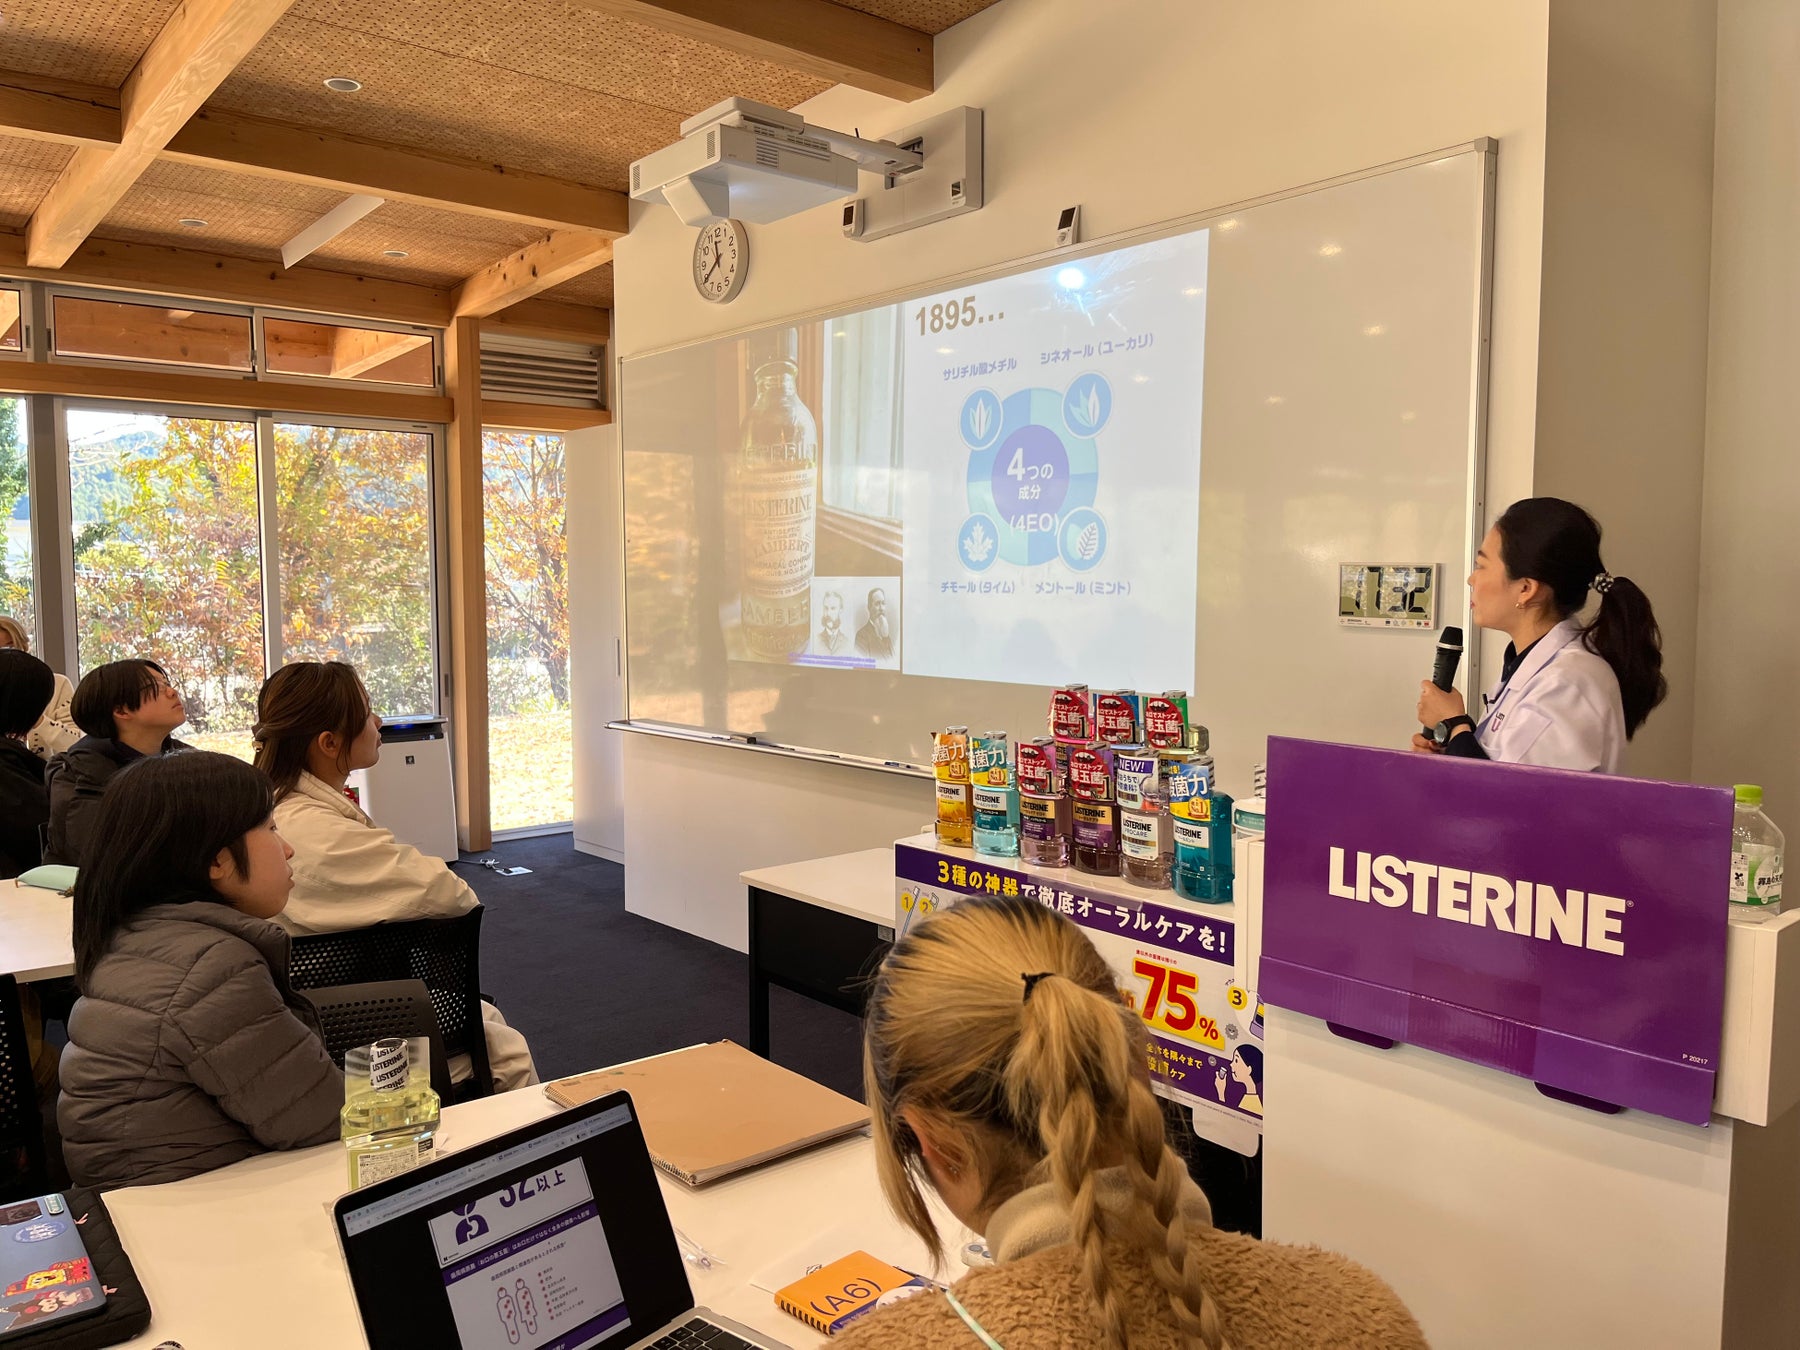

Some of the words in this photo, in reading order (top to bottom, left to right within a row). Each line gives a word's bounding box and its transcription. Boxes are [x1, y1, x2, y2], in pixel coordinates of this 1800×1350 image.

[1007, 447, 1054, 481] 4つの
[1018, 484, 1041, 500] 成分
[1099, 708, 1130, 717] 口でストップ
[1119, 758, 1145, 773] NEW!
[1070, 767, 1104, 785] 悪玉菌
[1075, 806, 1106, 818] LISTERINE
[1122, 818, 1152, 832] LISTERINE
[1174, 825, 1202, 840] LISTERINE
[1327, 846, 1627, 957] LISTERINE
[1231, 989, 1242, 1006] 3
[372, 1050, 404, 1072] LISTERINE
[810, 1277, 882, 1317] (A6)
